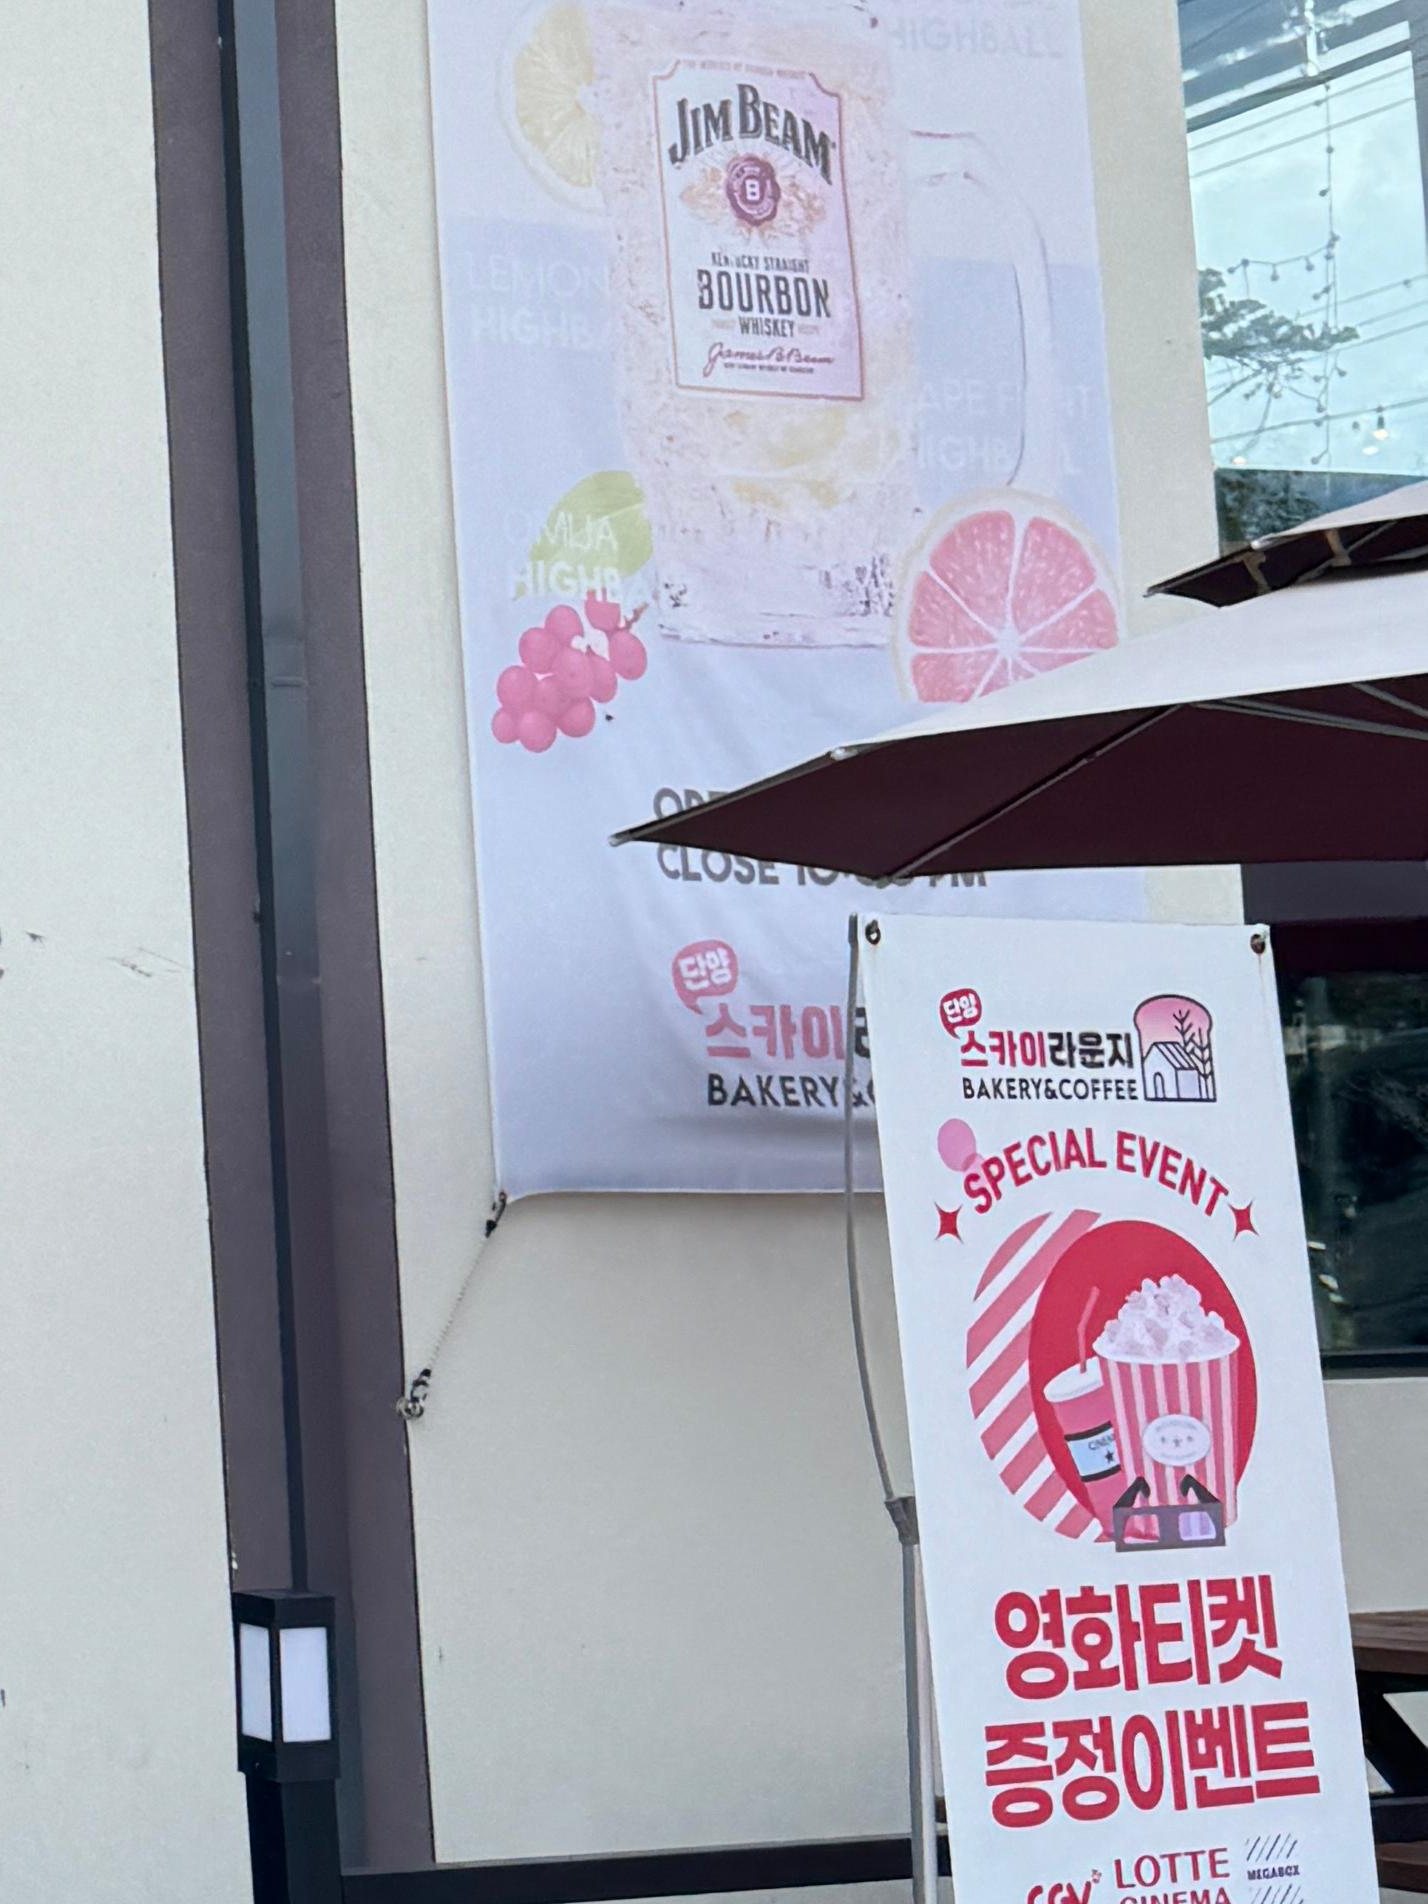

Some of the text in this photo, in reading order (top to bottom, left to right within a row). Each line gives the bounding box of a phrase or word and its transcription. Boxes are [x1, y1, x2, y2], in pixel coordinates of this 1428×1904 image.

[669, 82, 833, 186] JIM BEAM
[696, 268, 831, 319] BOURBON
[739, 315, 795, 338] WHISKEY
[656, 842, 780, 886] CLOSE
[677, 947, 732, 991] 단양
[942, 993, 980, 1023] 단양
[960, 1029, 1135, 1069] 스카이라운지
[961, 1076, 1139, 1101] BAKERY&COFFEE
[962, 1127, 1230, 1218] SPECIAL EVENT
[994, 1574, 1284, 1701] 영화티켓
[984, 1700, 1322, 1829] 증정이벤트
[1113, 1847, 1231, 1889] LOTTE
